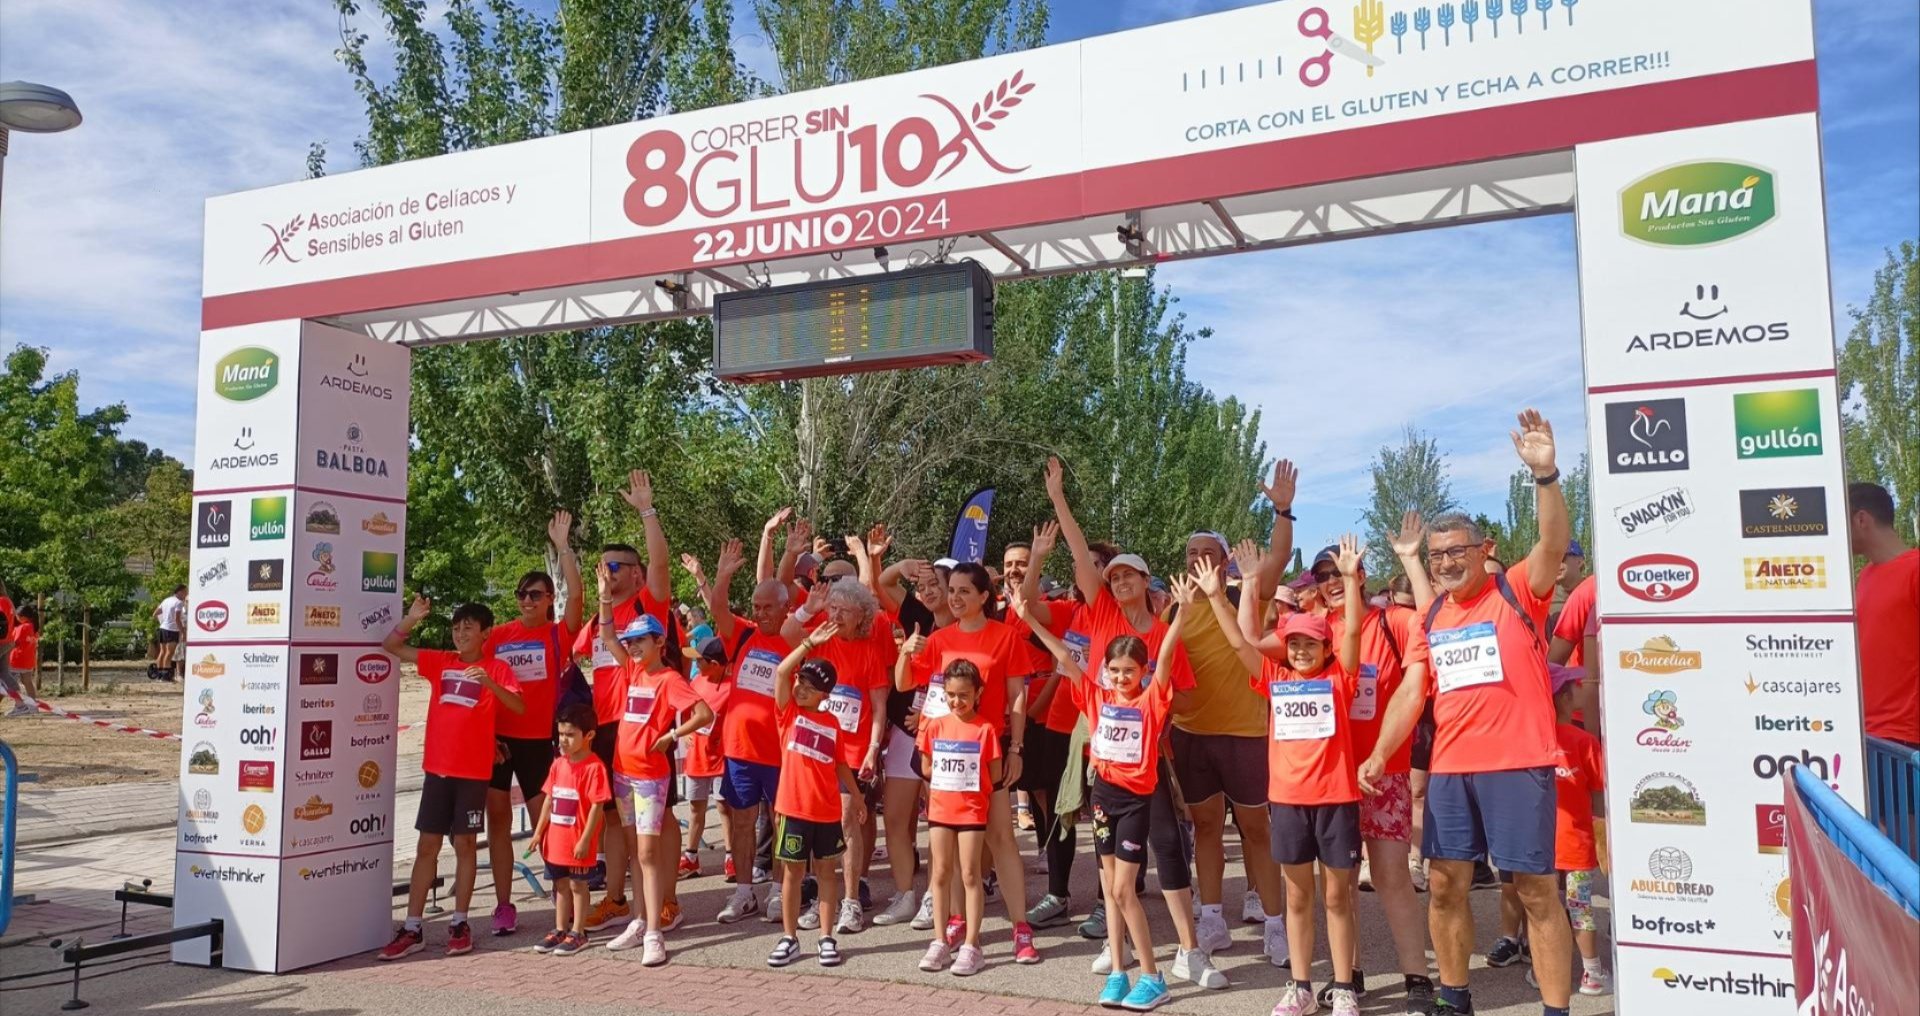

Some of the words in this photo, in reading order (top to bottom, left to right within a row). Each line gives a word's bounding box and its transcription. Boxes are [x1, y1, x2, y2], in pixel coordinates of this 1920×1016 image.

[1185, 119, 1251, 143] CORTA
[1257, 109, 1304, 132] CON
[1312, 104, 1336, 122] EL
[1341, 89, 1429, 118] GLUTEN
[1435, 85, 1450, 104] Y
[1457, 75, 1520, 100] ECHA
[1527, 71, 1544, 89] A
[1550, 50, 1671, 86] CORRER!!!
[690, 114, 798, 153] CORRER
[805, 104, 850, 135] SIN
[623, 129, 689, 227] 8
[1640, 176, 1758, 220] Maná
[307, 202, 394, 231] Asociación
[399, 197, 420, 216] de
[425, 187, 501, 211] Celíacos
[505, 183, 516, 203] y
[1648, 221, 1695, 233] Productos
[1717, 215, 1751, 225] Gluten
[307, 229, 383, 257] Sensibles
[388, 225, 403, 244] al
[408, 216, 464, 241] Gluten
[1626, 322, 1789, 353] ARDEMOS
[320, 375, 392, 400] ARDEMOS
[1741, 428, 1818, 455] gullón
[210, 453, 279, 470] ARDEMOS
[316, 450, 389, 478] BALBOA
[1617, 449, 1685, 467] GALLO
[1663, 512, 1677, 524] FOR
[251, 520, 284, 538] gullón
[1746, 523, 1824, 534] CASTELNUOVO
[201, 533, 229, 544] GALLO
[363, 575, 396, 589] gullón
[1765, 577, 1807, 585] NATURAL
[1746, 634, 1834, 651] Schnitzer
[243, 652, 279, 664] Schnitzer
[507, 654, 533, 667] 3064
[1445, 646, 1480, 666] 3207
[1626, 651, 1695, 668] Panceliac
[750, 663, 773, 679] 3199
[247, 681, 281, 692] cascajares
[455, 681, 462, 694] 1
[1762, 679, 1841, 696] cascajares
[243, 703, 275, 714] Iberitos
[628, 699, 634, 710] 1
[824, 698, 849, 714] 3197
[1285, 701, 1317, 717] 3206
[1755, 714, 1834, 732] Iberitos
[240, 725, 277, 751] ooh!
[813, 735, 820, 749] 1
[303, 747, 330, 757] GALLO
[941, 758, 965, 773] 3175
[295, 770, 334, 780] Schnitzer
[552, 800, 558, 813] 1
[350, 813, 386, 836] ooh!
[240, 839, 265, 847] VERNA
[193, 865, 266, 884] eventsthinker
[303, 857, 380, 881] eventsthinker
[1631, 880, 1714, 896] ABUELOBREAD
